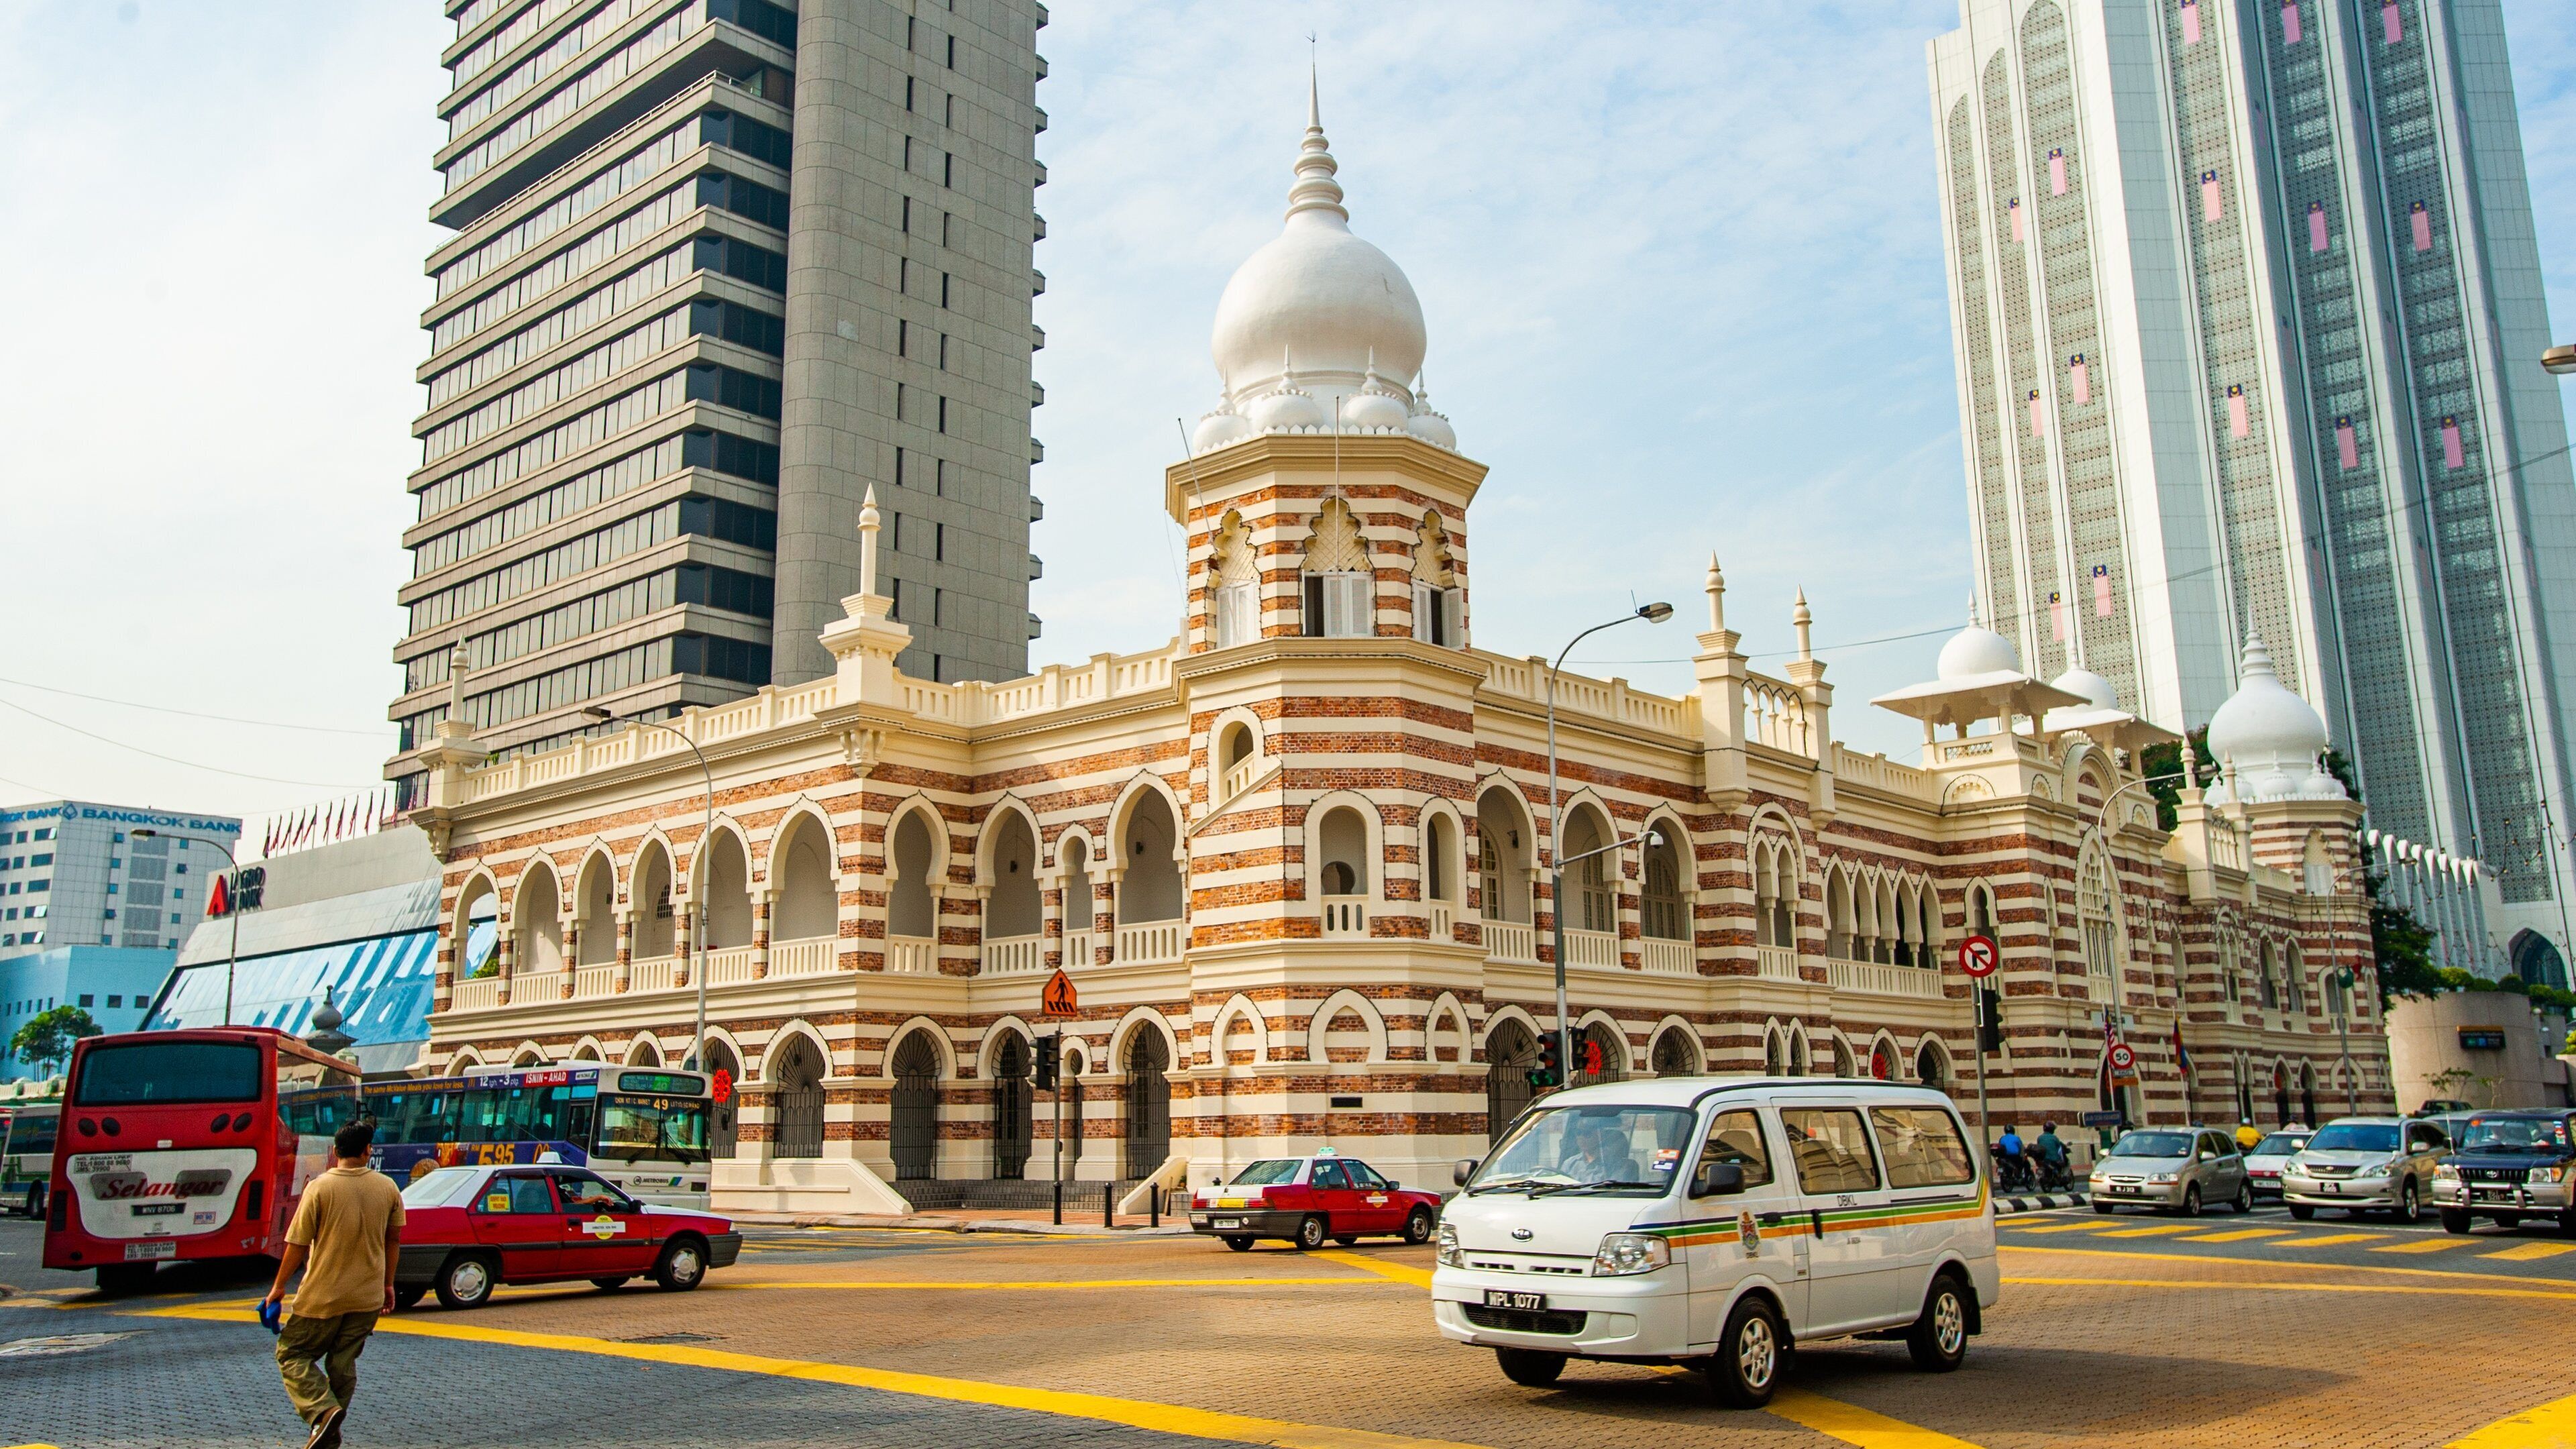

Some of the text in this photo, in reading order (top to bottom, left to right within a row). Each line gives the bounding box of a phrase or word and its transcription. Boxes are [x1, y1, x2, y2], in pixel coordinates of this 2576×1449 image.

[27, 806, 63, 820] BANK
[82, 808, 242, 833] BANGKOK BANK
[2115, 1053, 2129, 1061] 50
[479, 1075, 488, 1087] 12
[526, 1073, 543, 1084] ISNIN
[548, 1071, 567, 1083] AHAD
[423, 1083, 433, 1093] you
[653, 1097, 669, 1111] 49
[102, 1178, 223, 1199] Selangor
[1837, 1195, 1858, 1207] DBKL
[1489, 1291, 1541, 1309] WPL 1077
